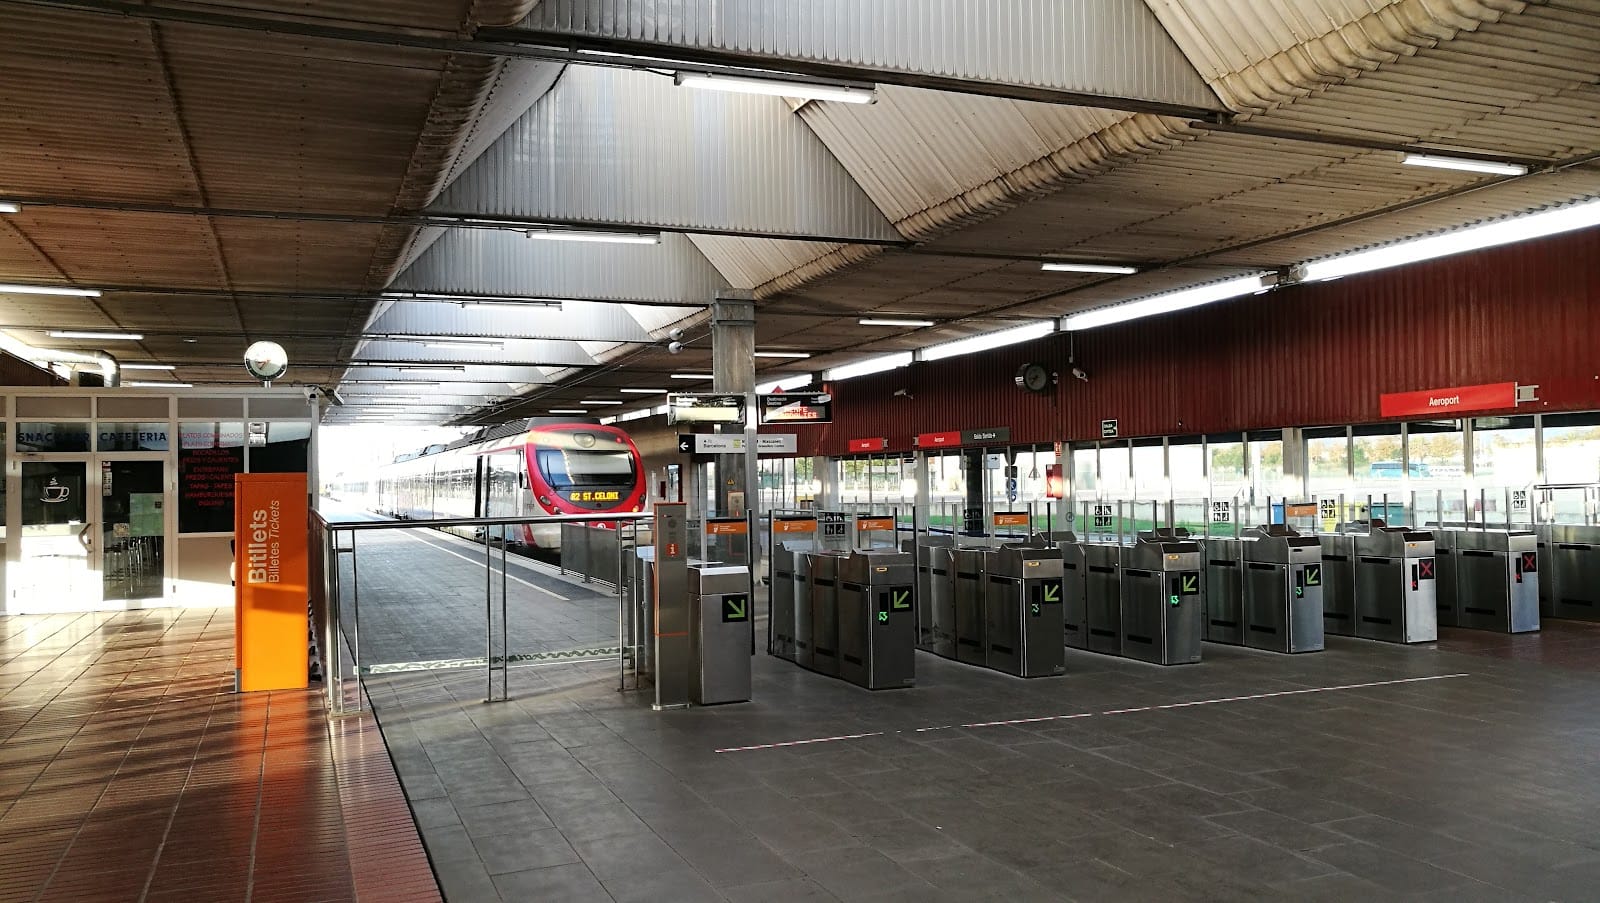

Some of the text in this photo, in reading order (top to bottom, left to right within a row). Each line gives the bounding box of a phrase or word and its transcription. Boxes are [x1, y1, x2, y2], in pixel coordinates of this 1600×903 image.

[1429, 395, 1460, 407] Aeroport
[248, 509, 268, 583] Bitllets
[268, 500, 280, 582] Billetes Tickets
